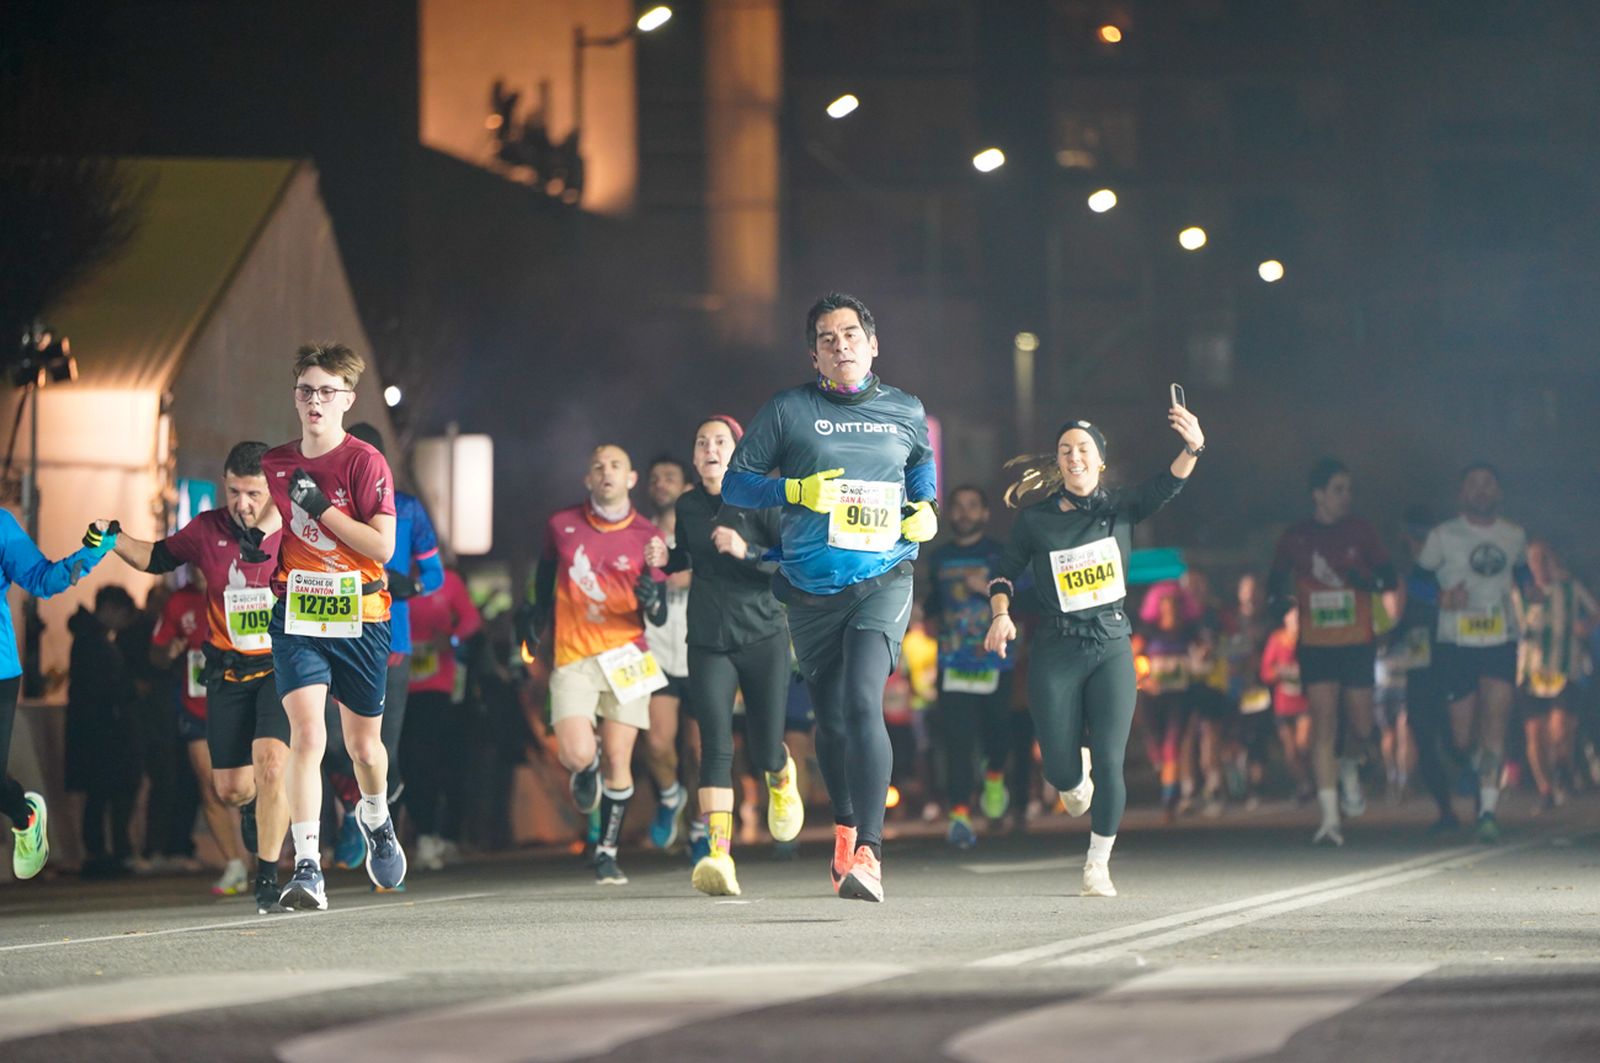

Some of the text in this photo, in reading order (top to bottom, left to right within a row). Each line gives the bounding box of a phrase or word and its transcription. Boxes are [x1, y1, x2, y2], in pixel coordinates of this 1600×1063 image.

[836, 423, 862, 433] NTT
[846, 505, 889, 528] 9612
[302, 524, 319, 543] 43
[303, 578, 324, 587] NOCHE
[1064, 562, 1115, 589] 13644
[295, 585, 309, 593] SAN
[297, 594, 351, 616] 12733
